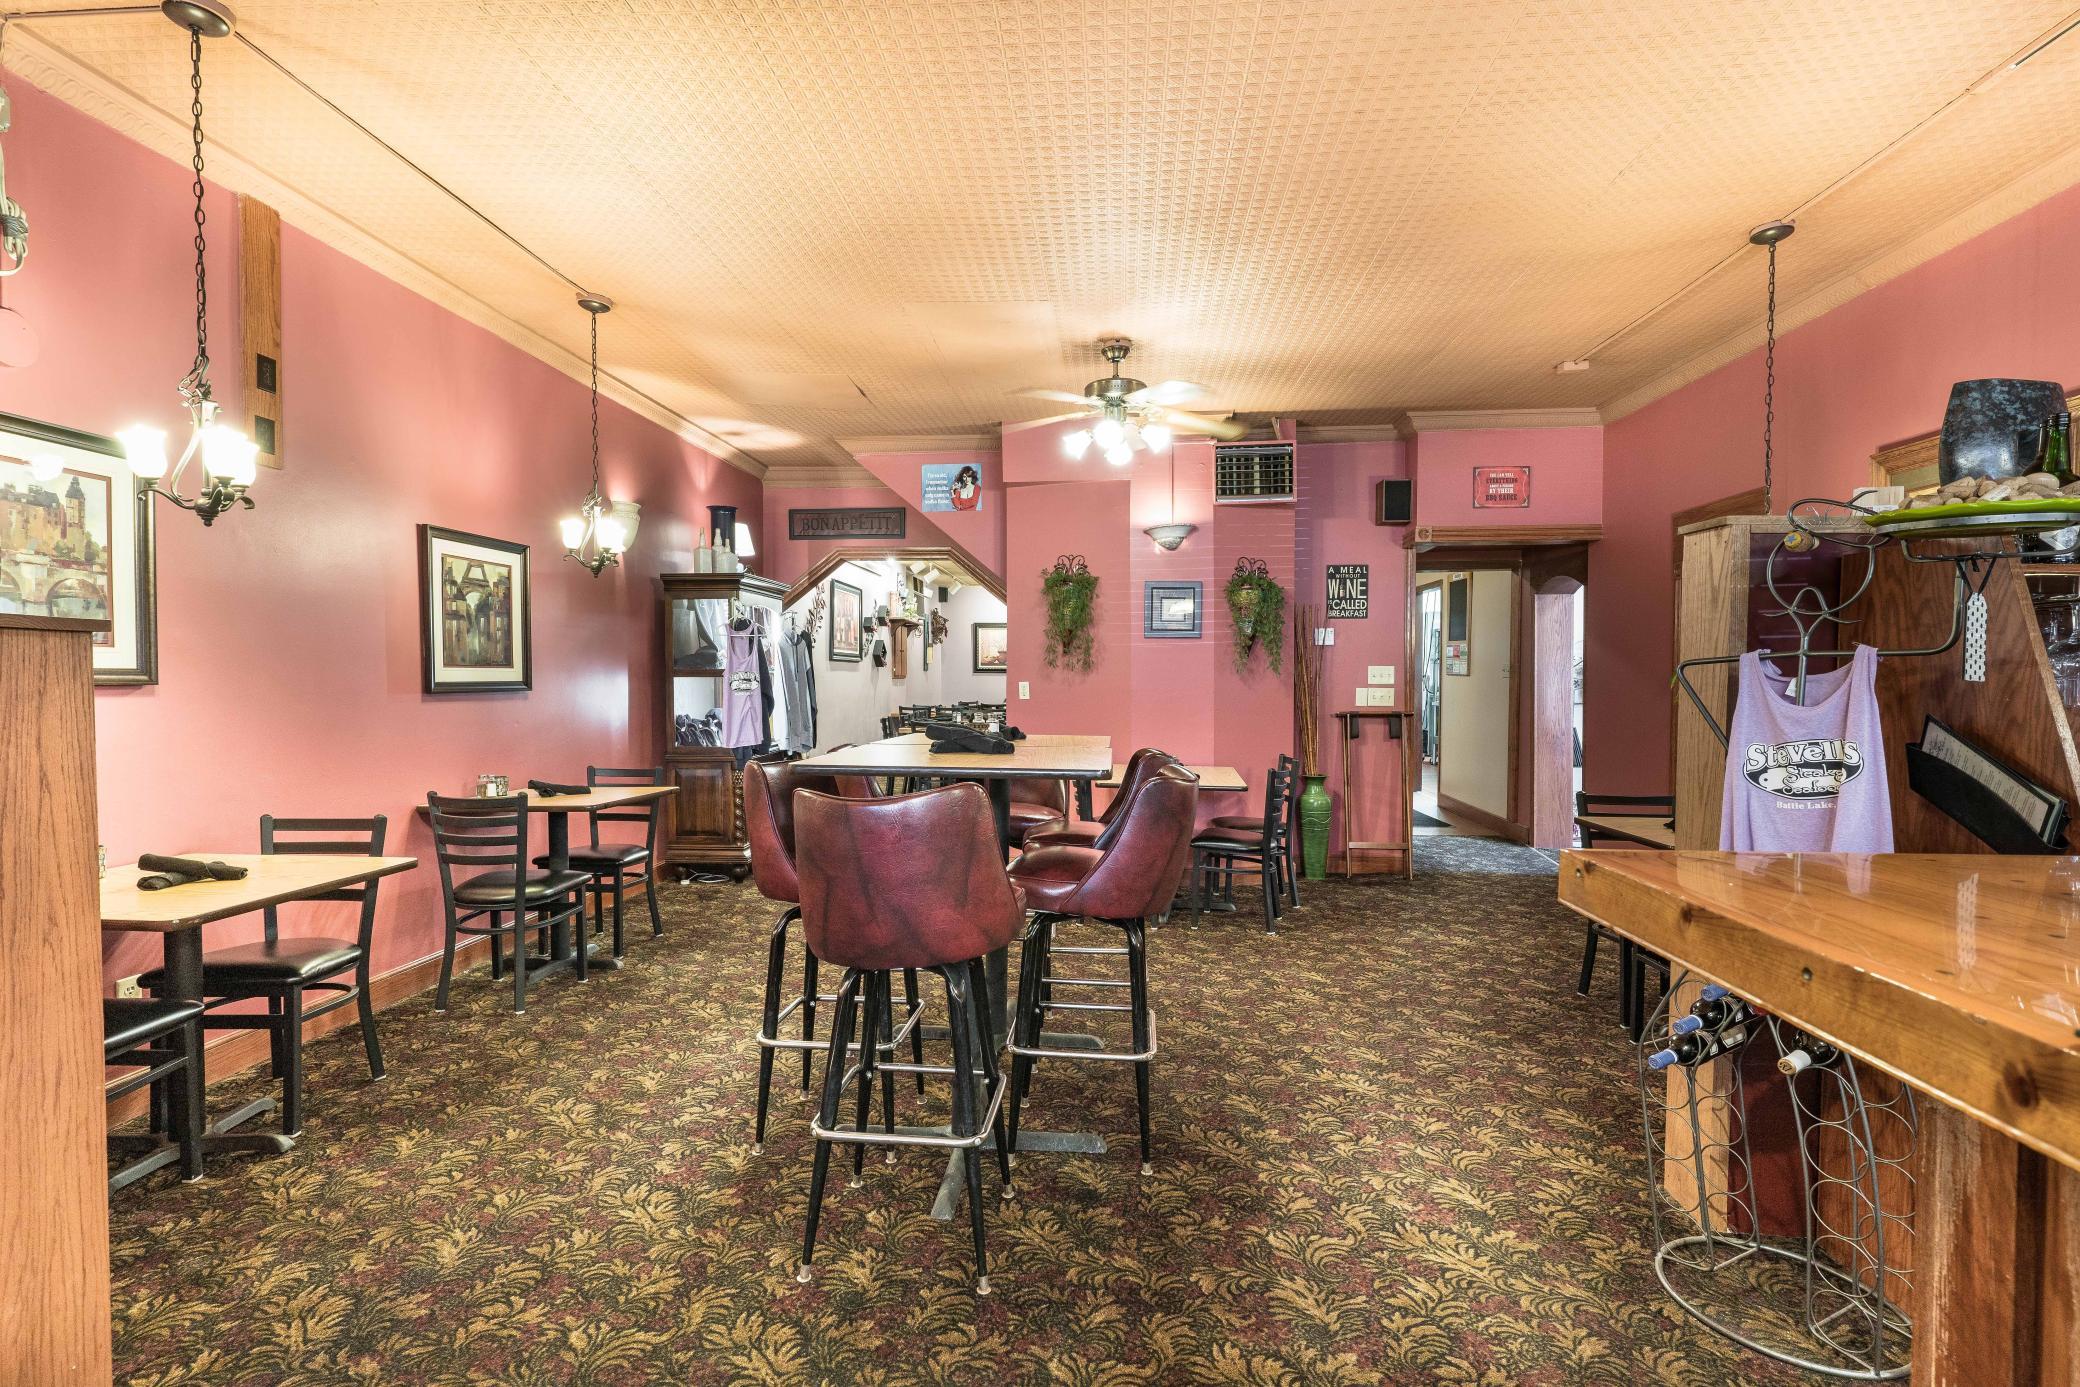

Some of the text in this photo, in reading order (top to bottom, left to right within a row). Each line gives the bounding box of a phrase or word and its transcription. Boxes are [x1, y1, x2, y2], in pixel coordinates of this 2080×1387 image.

[801, 518, 829, 531] BON
[1328, 566, 1367, 574] A MEAL
[1332, 599, 1367, 610] CALLED
[1328, 609, 1367, 617] BREAKFAST
[1776, 801, 1805, 810] Battle
